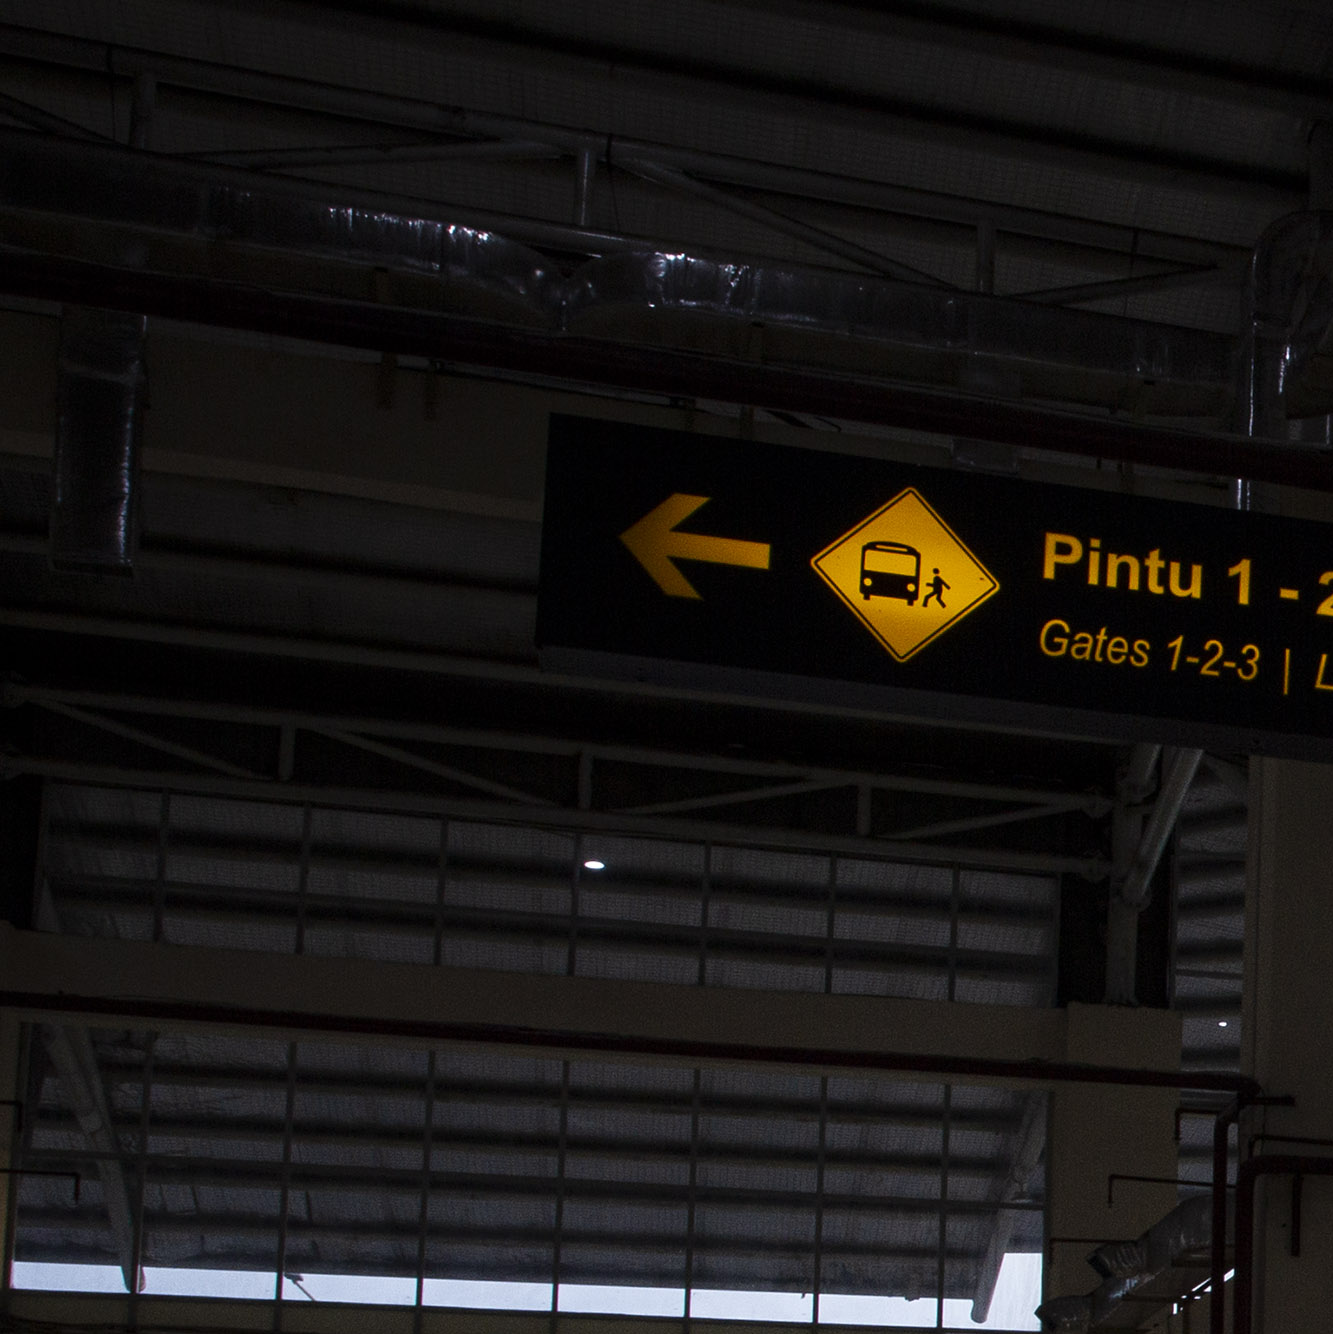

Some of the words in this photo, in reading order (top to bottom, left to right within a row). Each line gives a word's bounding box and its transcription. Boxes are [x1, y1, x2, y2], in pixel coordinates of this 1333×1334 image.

[1043, 533, 1203, 599] Pintu
[1228, 558, 1251, 606] 1
[1040, 618, 1151, 667] Gates
[1167, 634, 1260, 681] 1-2-3
